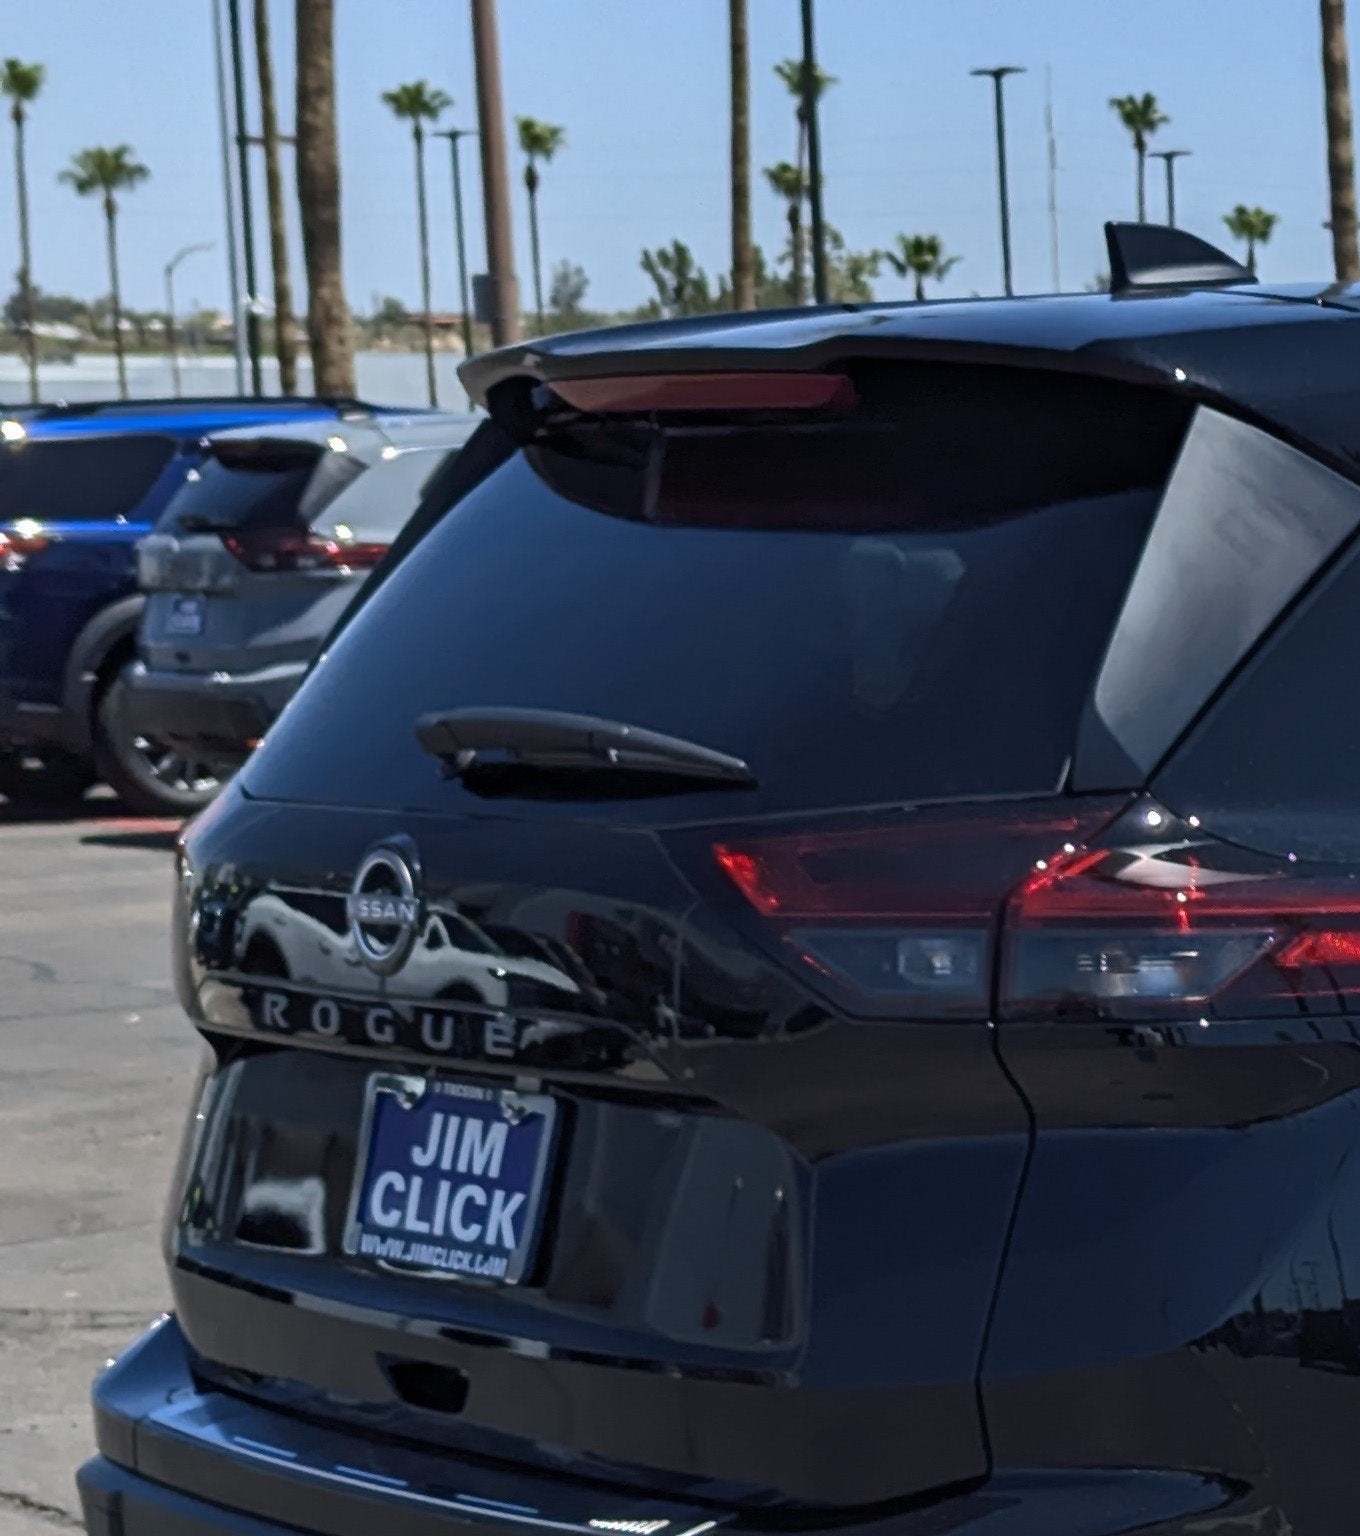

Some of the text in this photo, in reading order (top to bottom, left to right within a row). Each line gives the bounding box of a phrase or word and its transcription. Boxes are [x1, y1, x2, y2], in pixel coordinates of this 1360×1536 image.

[352, 898, 416, 922] SSAN
[262, 992, 515, 1056] ROGUE
[411, 1112, 508, 1179] JIM
[370, 1170, 526, 1250] CLICK
